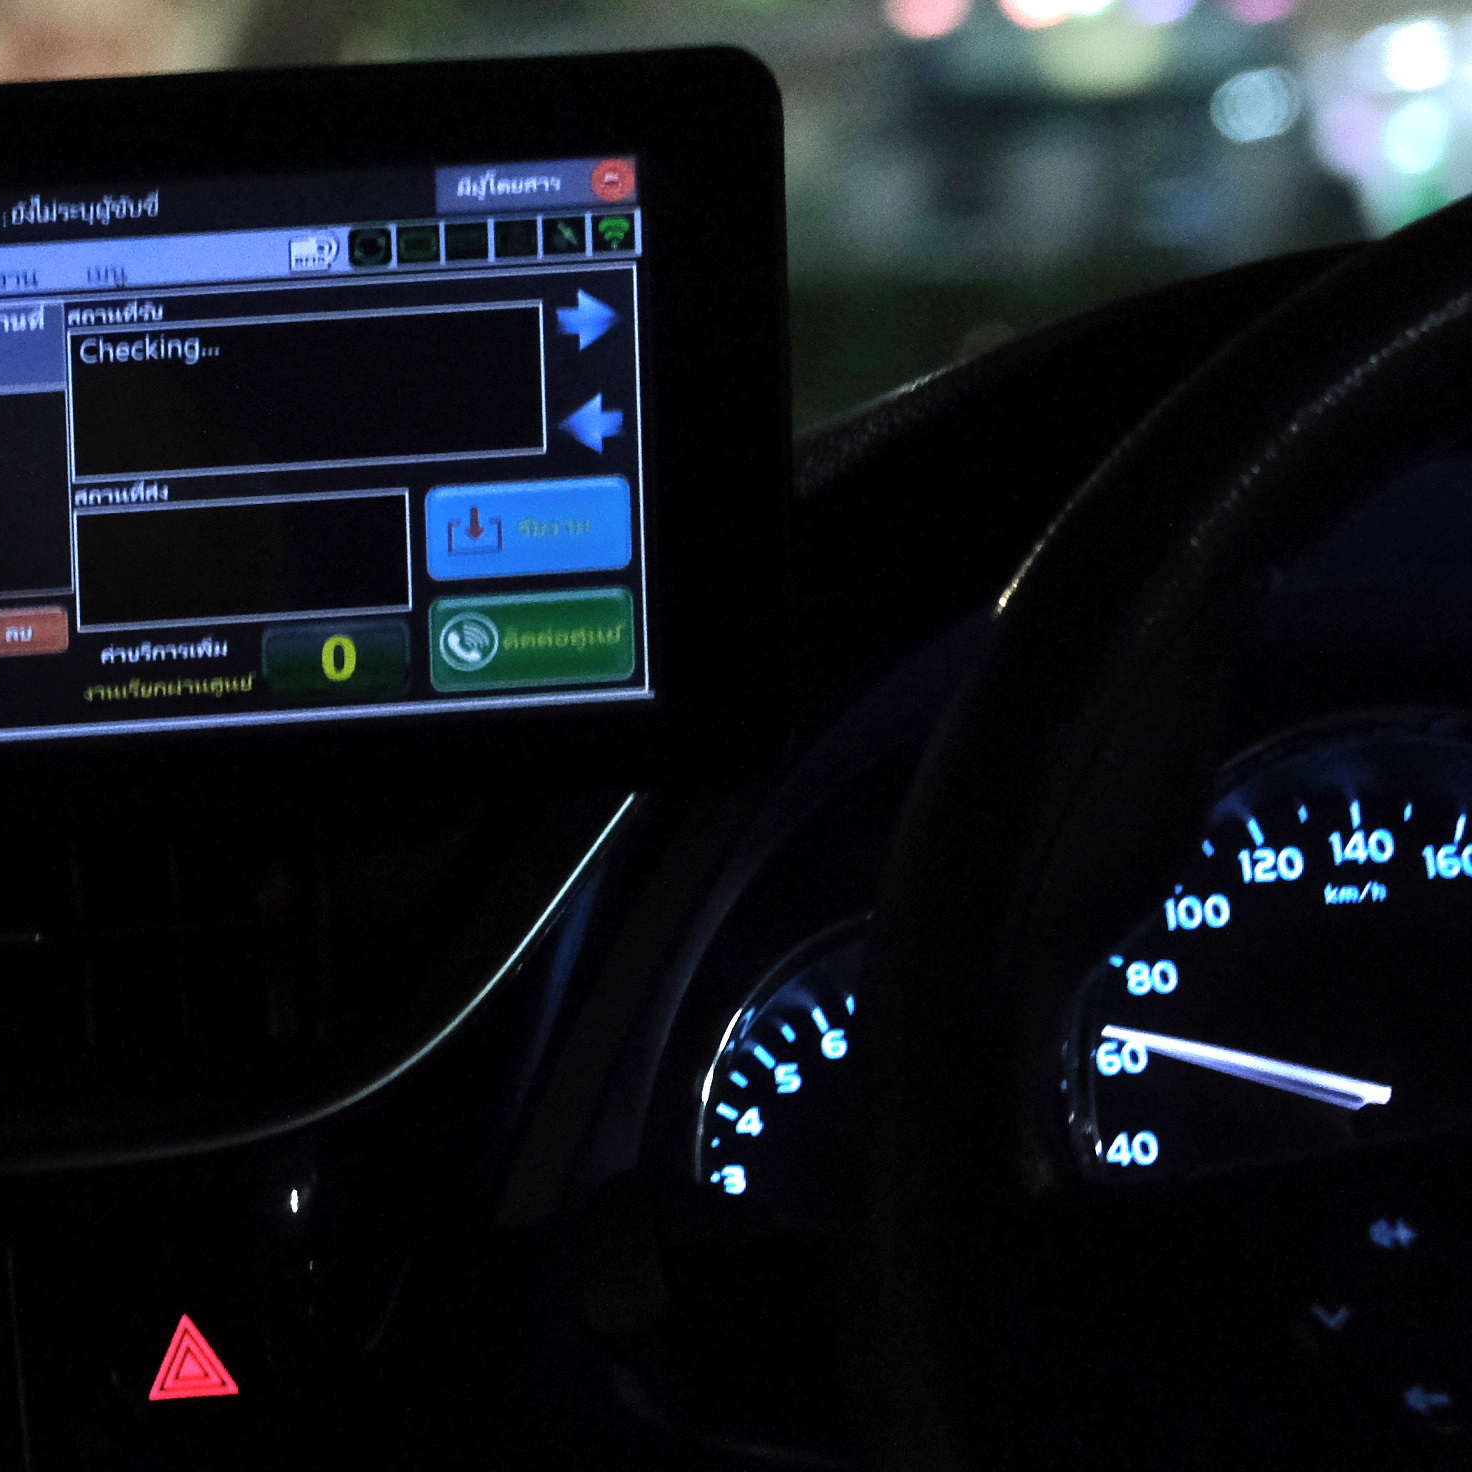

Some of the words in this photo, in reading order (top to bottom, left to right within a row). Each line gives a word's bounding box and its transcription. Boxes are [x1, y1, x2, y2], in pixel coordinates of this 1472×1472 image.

[80, 332, 220, 365] Checking...
[321, 635, 357, 681] 0
[1238, 845, 1305, 884] 120
[1328, 828, 1396, 866] 140
[1323, 880, 1388, 905] km/h
[1165, 892, 1231, 931] 100
[1126, 959, 1179, 996] 80
[820, 1028, 849, 1060] 6
[1096, 1039, 1148, 1076] 60
[774, 1061, 803, 1095] 5
[735, 1105, 765, 1138] 4
[1106, 1130, 1160, 1167] 40
[720, 1163, 748, 1196] 3
